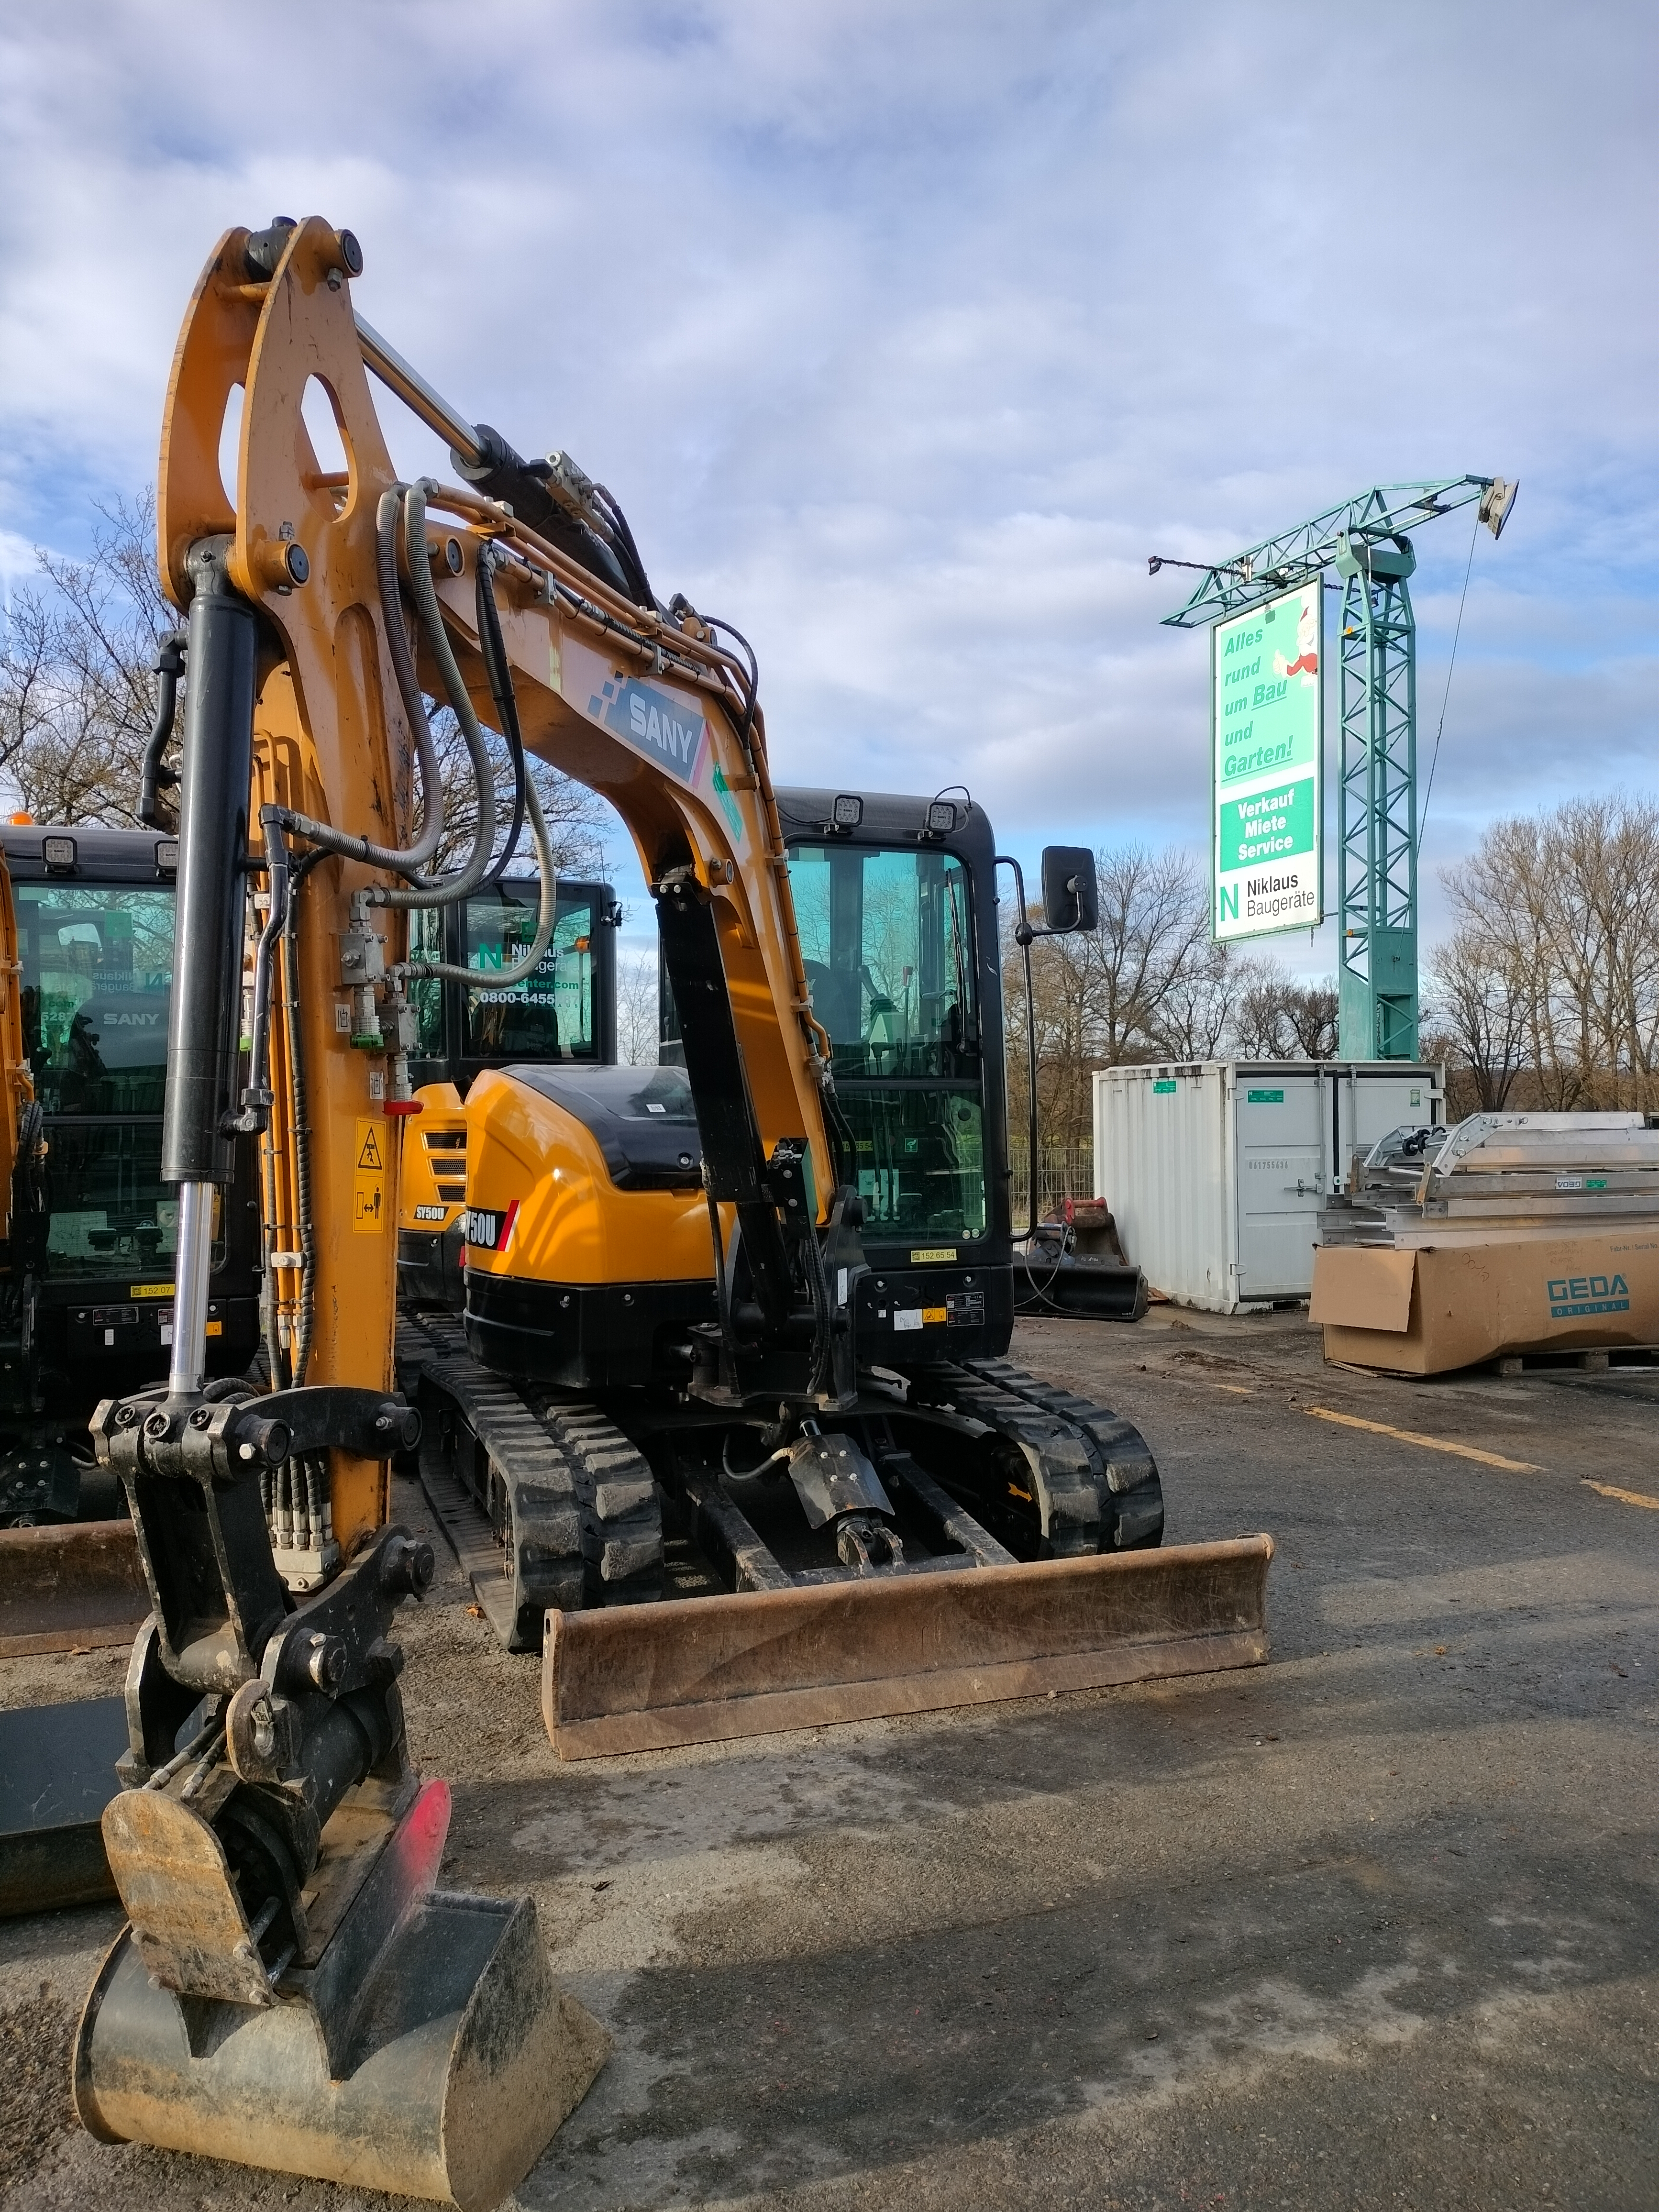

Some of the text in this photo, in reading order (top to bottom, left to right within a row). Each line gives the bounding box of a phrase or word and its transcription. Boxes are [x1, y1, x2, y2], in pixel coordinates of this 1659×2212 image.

[1224, 629, 1262, 657] Alles
[1225, 656, 1261, 686] rund
[1225, 680, 1287, 716] um Bau
[630, 693, 693, 763] SANY
[1225, 720, 1253, 746] und
[1225, 735, 1294, 776] Garten!
[1238, 788, 1294, 819] Verkauf
[1245, 815, 1286, 839] Miete
[1238, 836, 1293, 861] Service
[1248, 874, 1298, 897] Niklaus
[1220, 884, 1239, 922] N
[1248, 890, 1315, 917] Baugeräte
[479, 943, 502, 969] N
[103, 1013, 159, 1025] SANY
[1249, 1161, 1288, 1169] 061755636
[416, 1206, 444, 1220] SY50U
[1547, 1274, 1628, 1301] GEDA
[1557, 1302, 1626, 1316] ORIGINAL
